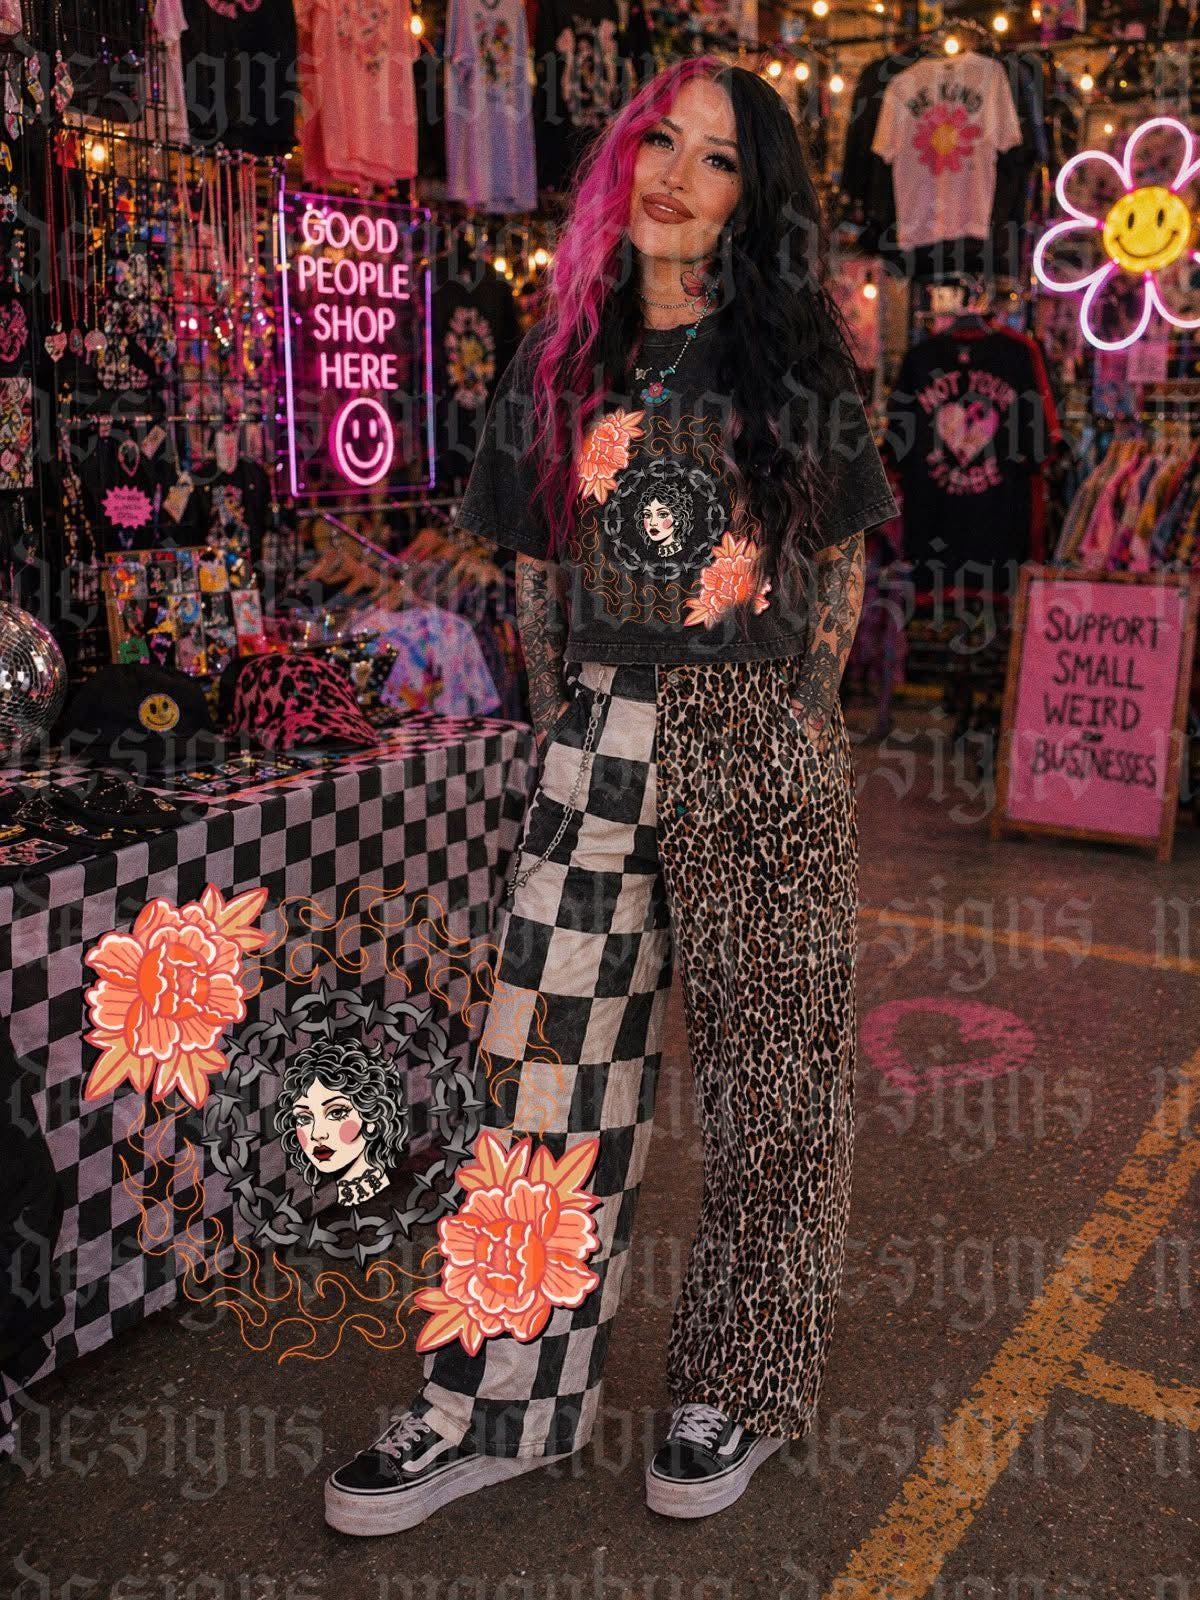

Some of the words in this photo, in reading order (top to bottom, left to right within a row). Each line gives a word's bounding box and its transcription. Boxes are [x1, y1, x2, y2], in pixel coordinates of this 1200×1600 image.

[302, 208, 399, 254] GOOD
[298, 255, 411, 300] PEOPLE
[313, 303, 396, 344] SHOP
[320, 352, 399, 390] HERE
[1044, 606, 1161, 649] SUPPORT
[1052, 650, 1145, 691] SMALL
[1043, 692, 1141, 732] WEIRD
[1031, 737, 1158, 788] BUSINESSES
